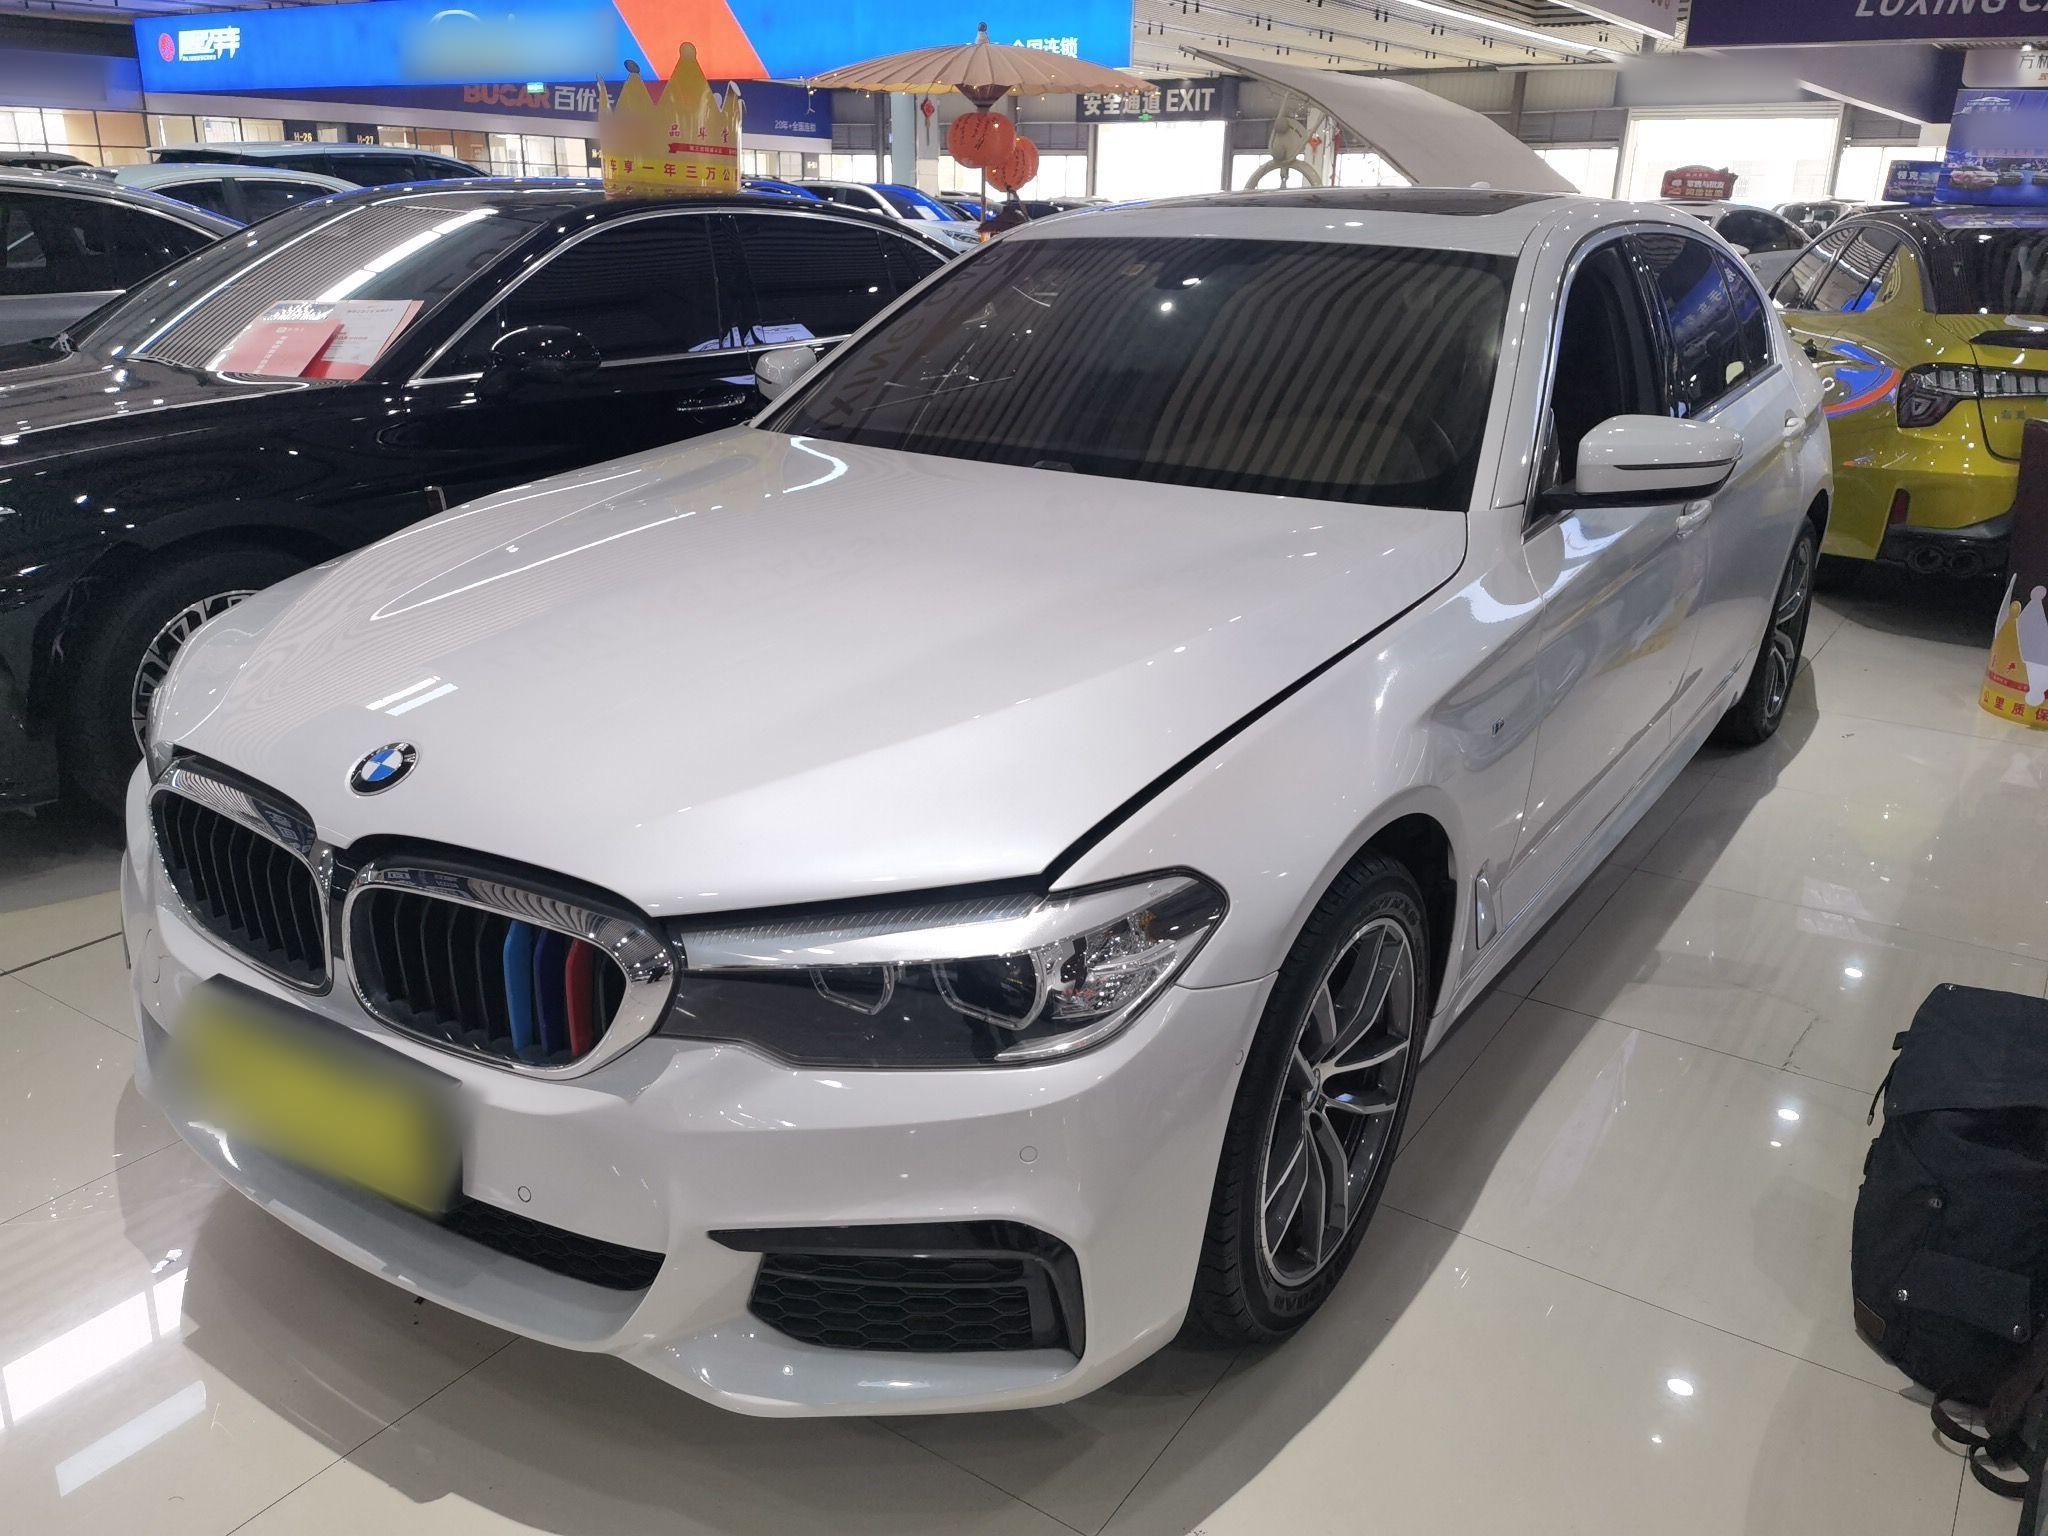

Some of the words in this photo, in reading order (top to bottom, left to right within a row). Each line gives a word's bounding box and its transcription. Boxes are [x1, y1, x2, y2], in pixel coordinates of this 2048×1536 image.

[463, 84, 550, 109] BUCAR
[1083, 92, 1161, 116] 安全通道
[1165, 88, 1215, 112] EXIT
[610, 159, 738, 181] 车享一年三万公
